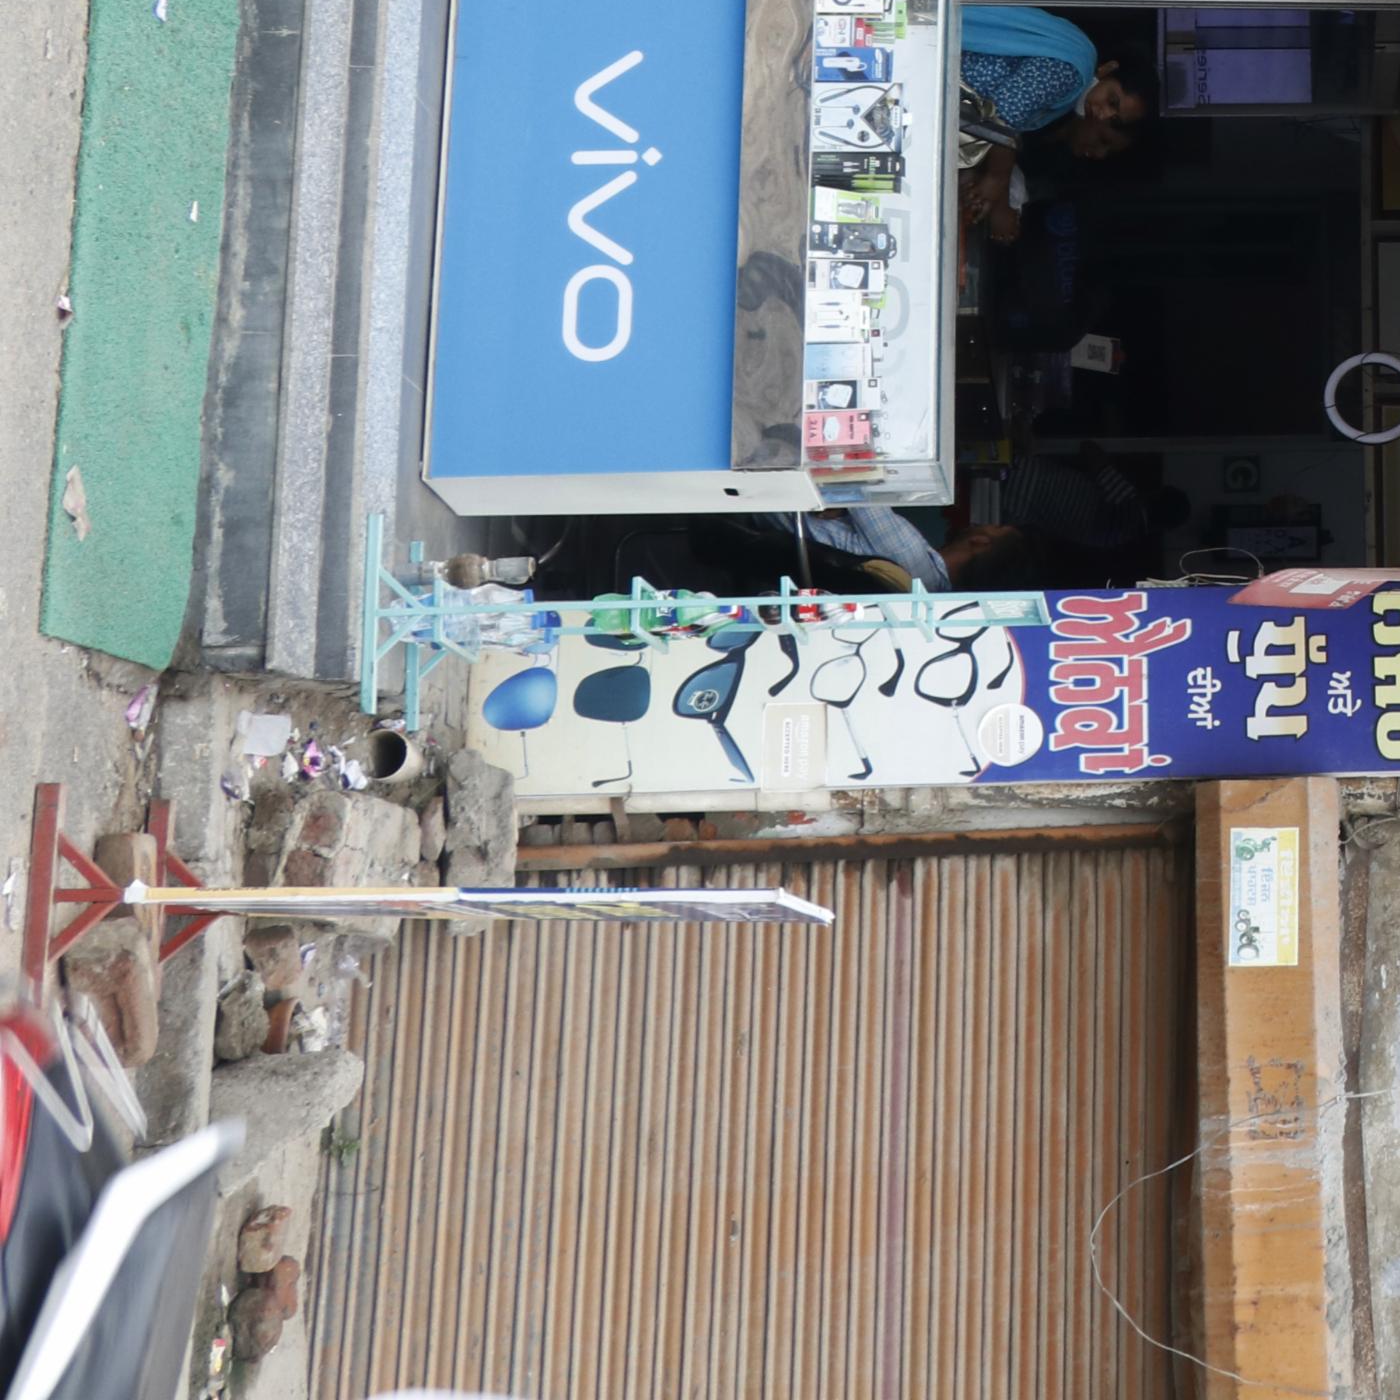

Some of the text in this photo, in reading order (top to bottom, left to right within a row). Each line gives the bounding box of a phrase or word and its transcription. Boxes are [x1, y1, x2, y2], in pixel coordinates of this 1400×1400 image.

[562, 50, 663, 362] vivo
[1048, 592, 1192, 774] ਐਨਕਾਂ
[1187, 666, 1222, 728] ਦੀਆਂ
[1327, 671, 1361, 716] ਅਤੇ
[783, 721, 791, 773] ACCEPTED HERE
[796, 714, 810, 780] amazon pay
[1017, 715, 1026, 754] amazon pay
